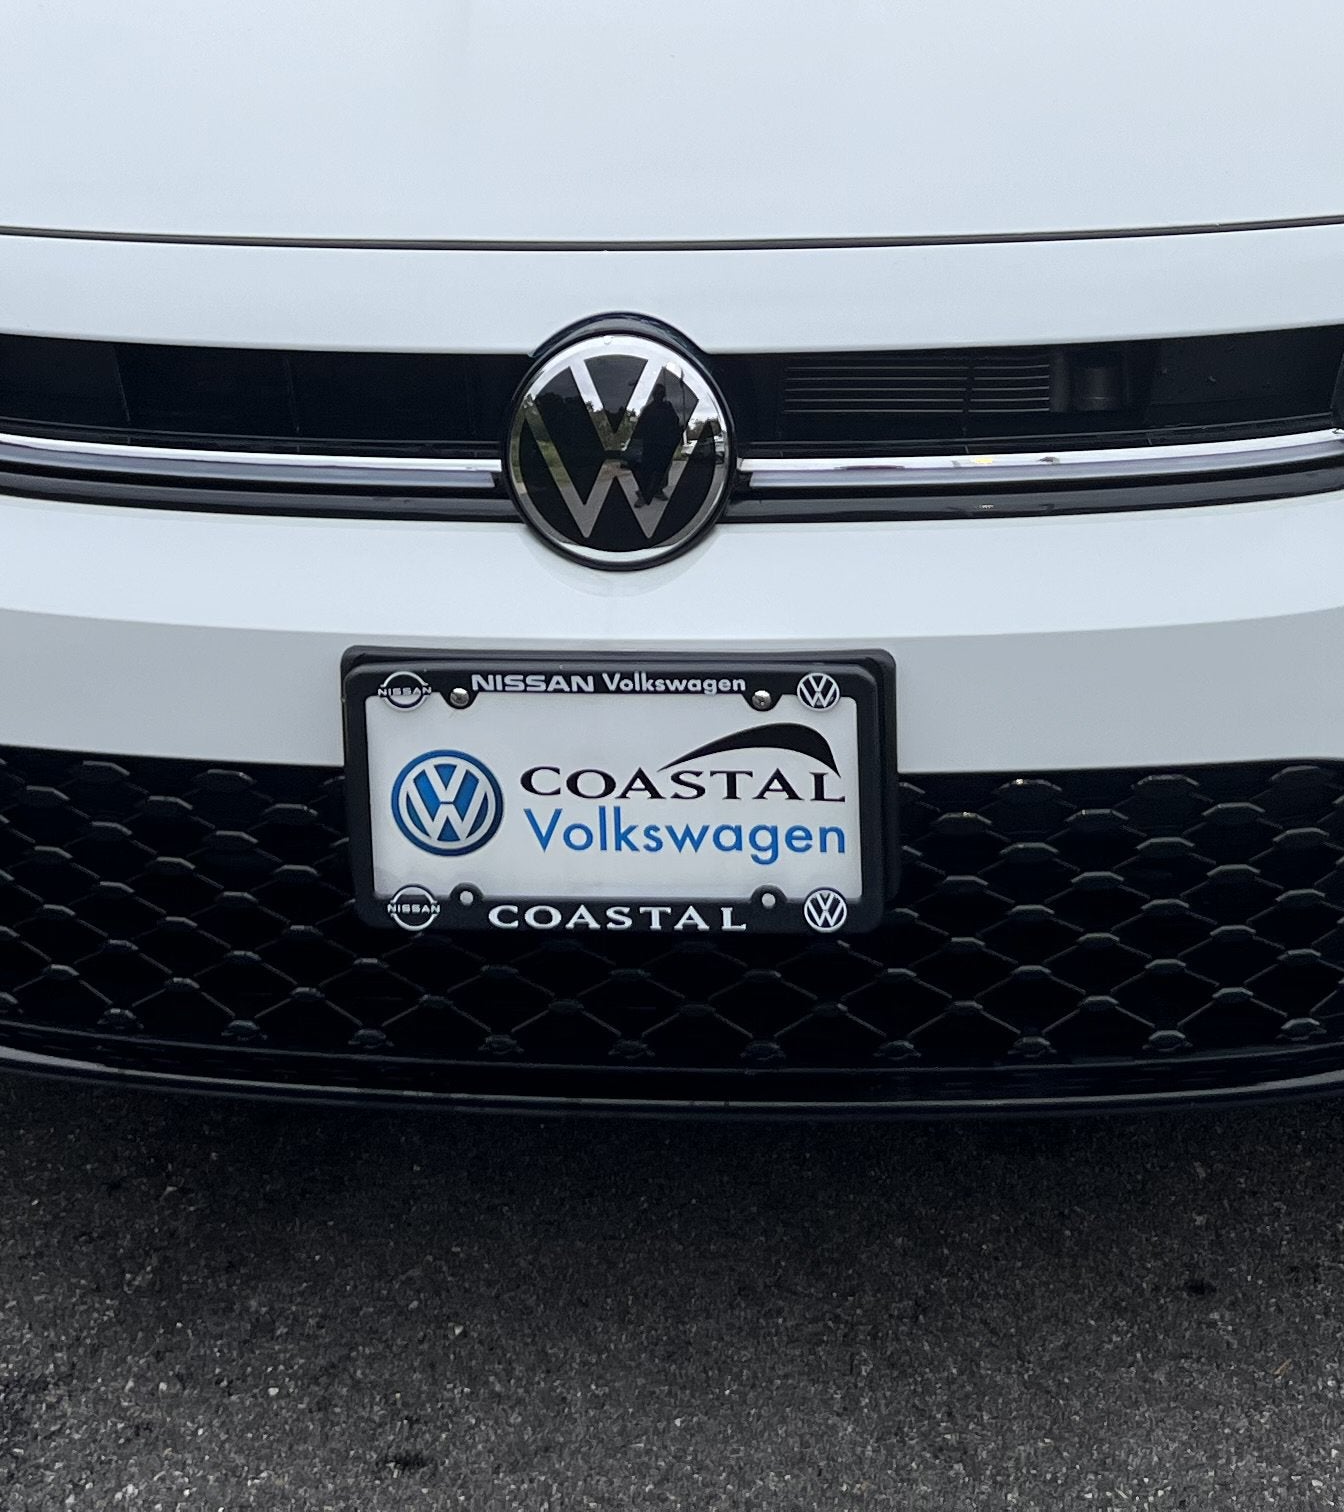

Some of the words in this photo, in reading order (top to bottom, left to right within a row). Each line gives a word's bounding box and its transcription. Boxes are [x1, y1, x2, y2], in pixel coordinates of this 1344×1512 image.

[518, 341, 720, 552] VW
[377, 686, 432, 697] NISSAN
[471, 674, 595, 693] NISSAN
[602, 671, 747, 696] Volkswagen
[519, 766, 846, 803] COASTAL
[523, 805, 846, 865] Volkswagen
[387, 903, 440, 914] NISSAN
[488, 904, 747, 930] COASTAL
